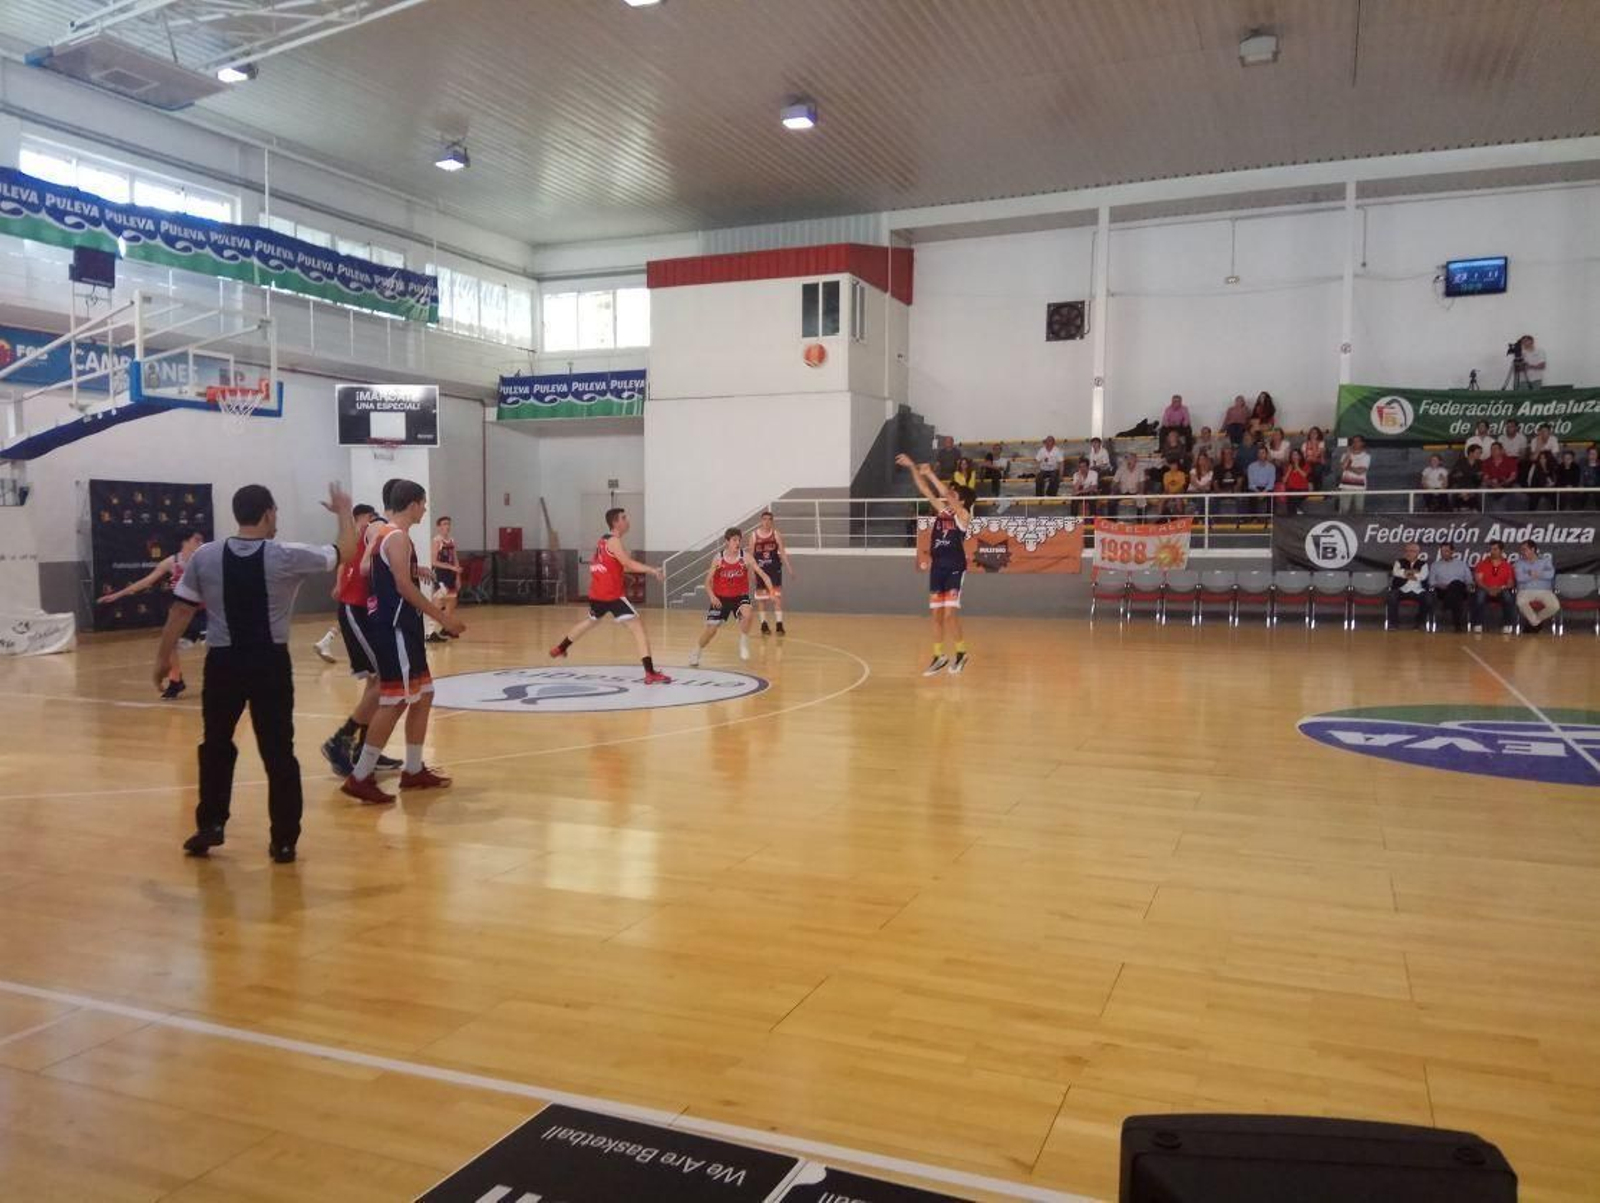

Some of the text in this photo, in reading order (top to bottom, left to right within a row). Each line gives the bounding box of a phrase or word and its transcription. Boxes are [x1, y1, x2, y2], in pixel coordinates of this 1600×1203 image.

[45, 193, 100, 219] PULEVA
[104, 209, 156, 231] PULEVA
[160, 220, 206, 242] PULEVA
[209, 231, 251, 249] PULEVA
[254, 240, 294, 261] PULEVA
[297, 252, 335, 272] PULEVA
[337, 263, 371, 283] PULEVA
[533, 383, 568, 393] PULEVA
[571, 381, 607, 391] PULEVA
[610, 379, 645, 390] PULEVA
[356, 402, 375, 410] UNA
[1419, 399, 1513, 416] Federación
[1449, 419, 1472, 434] de
[1364, 523, 1595, 544] Federación Andaluza
[1100, 537, 1148, 564] 1988
[541, 1125, 747, 1186] We Are Basketball
